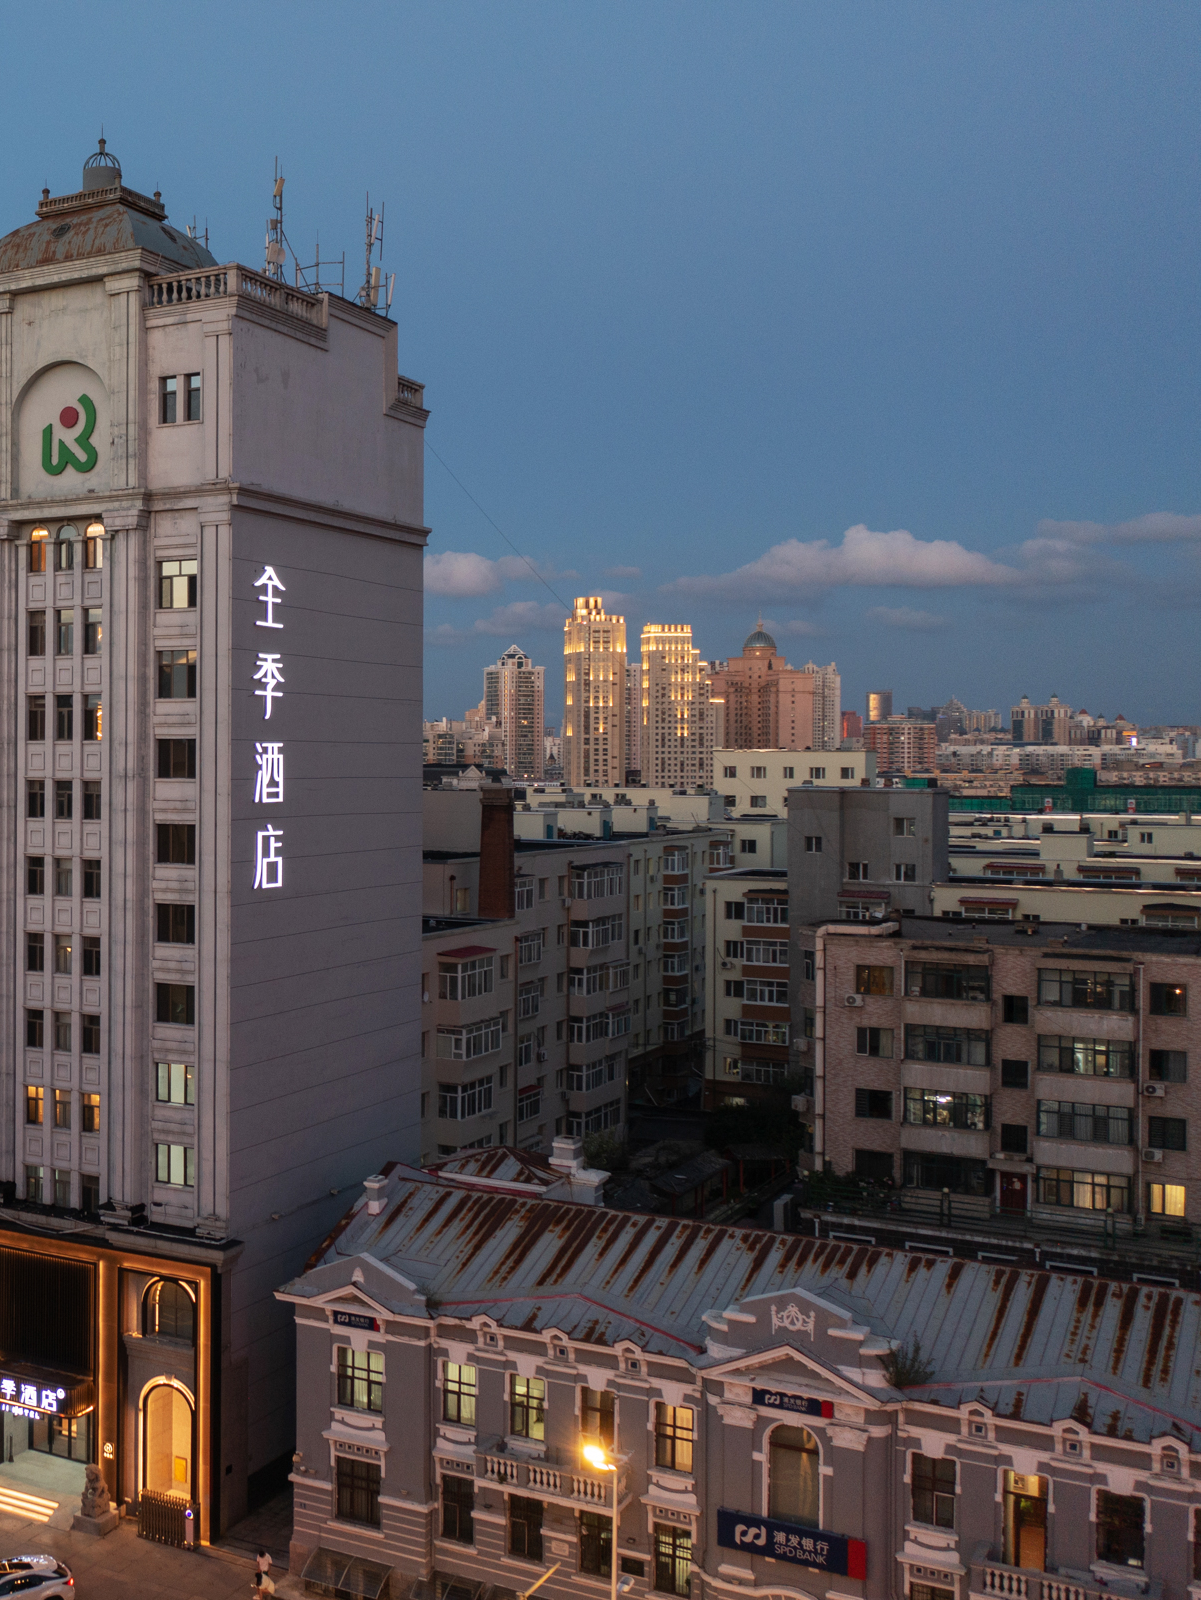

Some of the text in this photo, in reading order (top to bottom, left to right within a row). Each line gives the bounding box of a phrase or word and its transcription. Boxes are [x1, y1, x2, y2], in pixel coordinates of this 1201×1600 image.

[253, 566, 286, 889] 全季酒店
[773, 1530, 829, 1555] 浦发银行
[774, 1545, 827, 1565] SPD BANK
